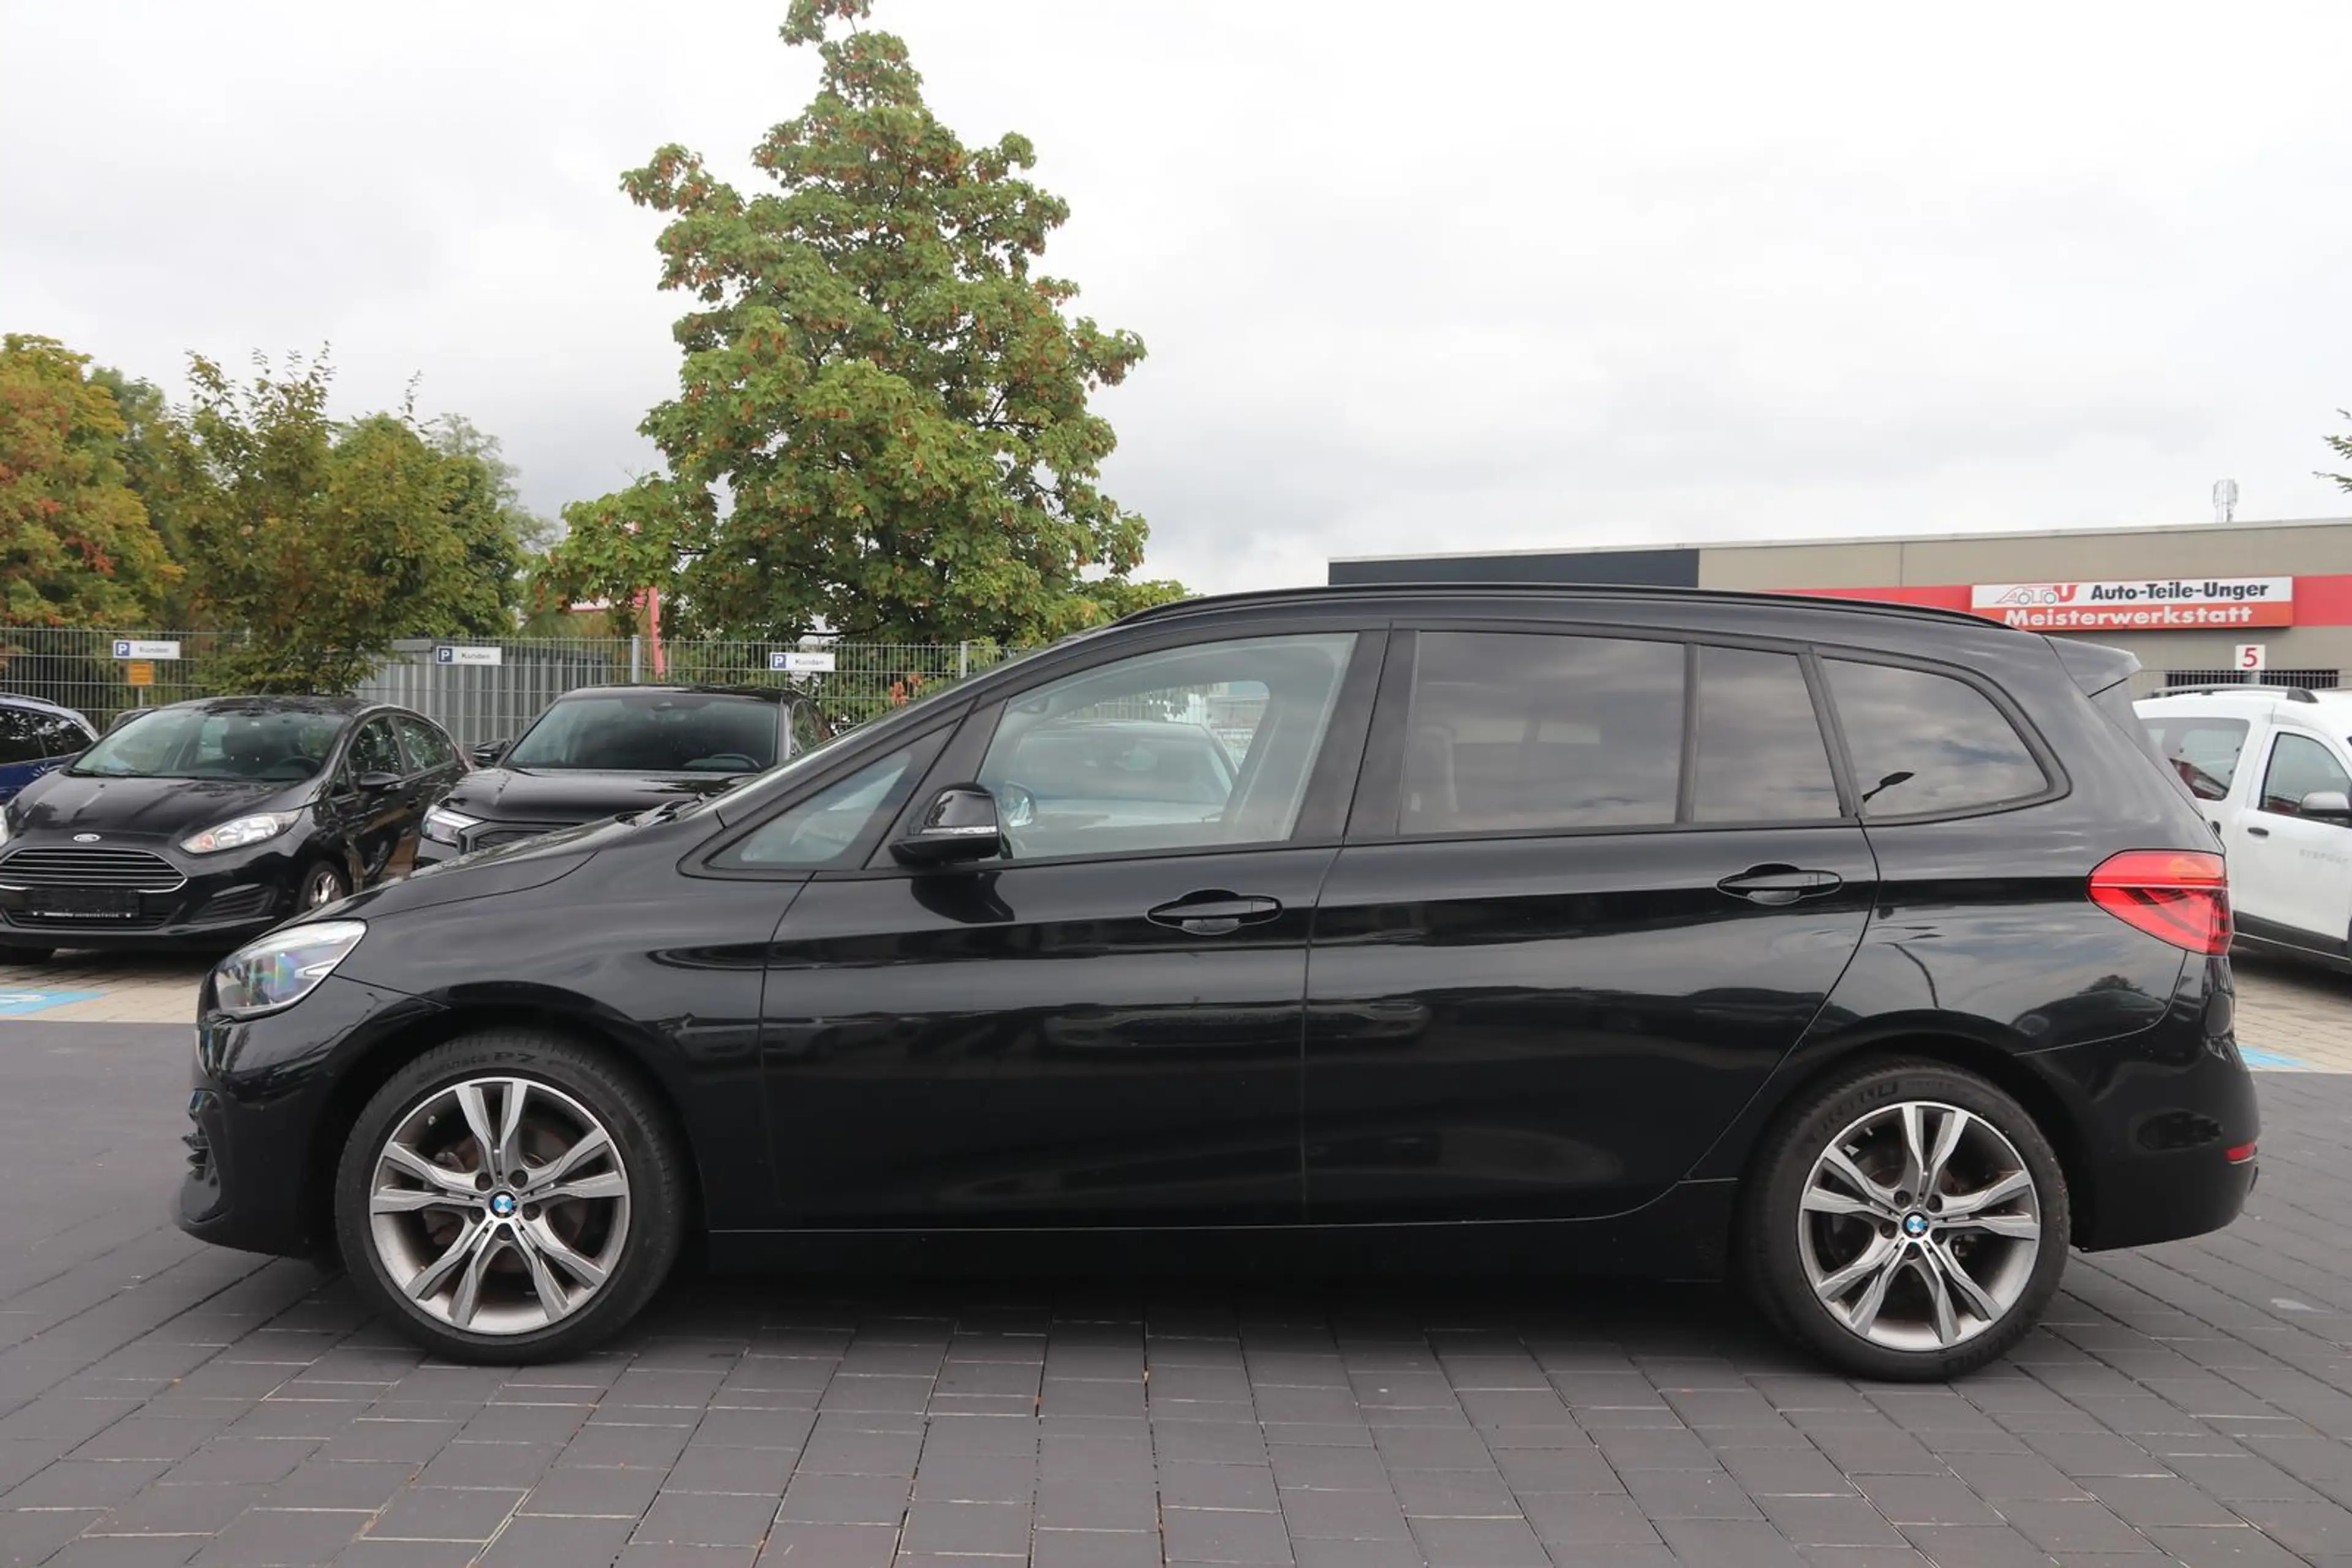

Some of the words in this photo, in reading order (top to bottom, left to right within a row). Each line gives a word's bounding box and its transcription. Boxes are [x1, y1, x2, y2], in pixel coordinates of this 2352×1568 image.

[2090, 582, 2269, 600] Auto-Teile-Unger
[2003, 606, 2252, 626] Meisterwerkstatt
[118, 644, 127, 655] P
[441, 650, 450, 661] P
[774, 656, 784, 667] P
[2242, 647, 2258, 668] 5
